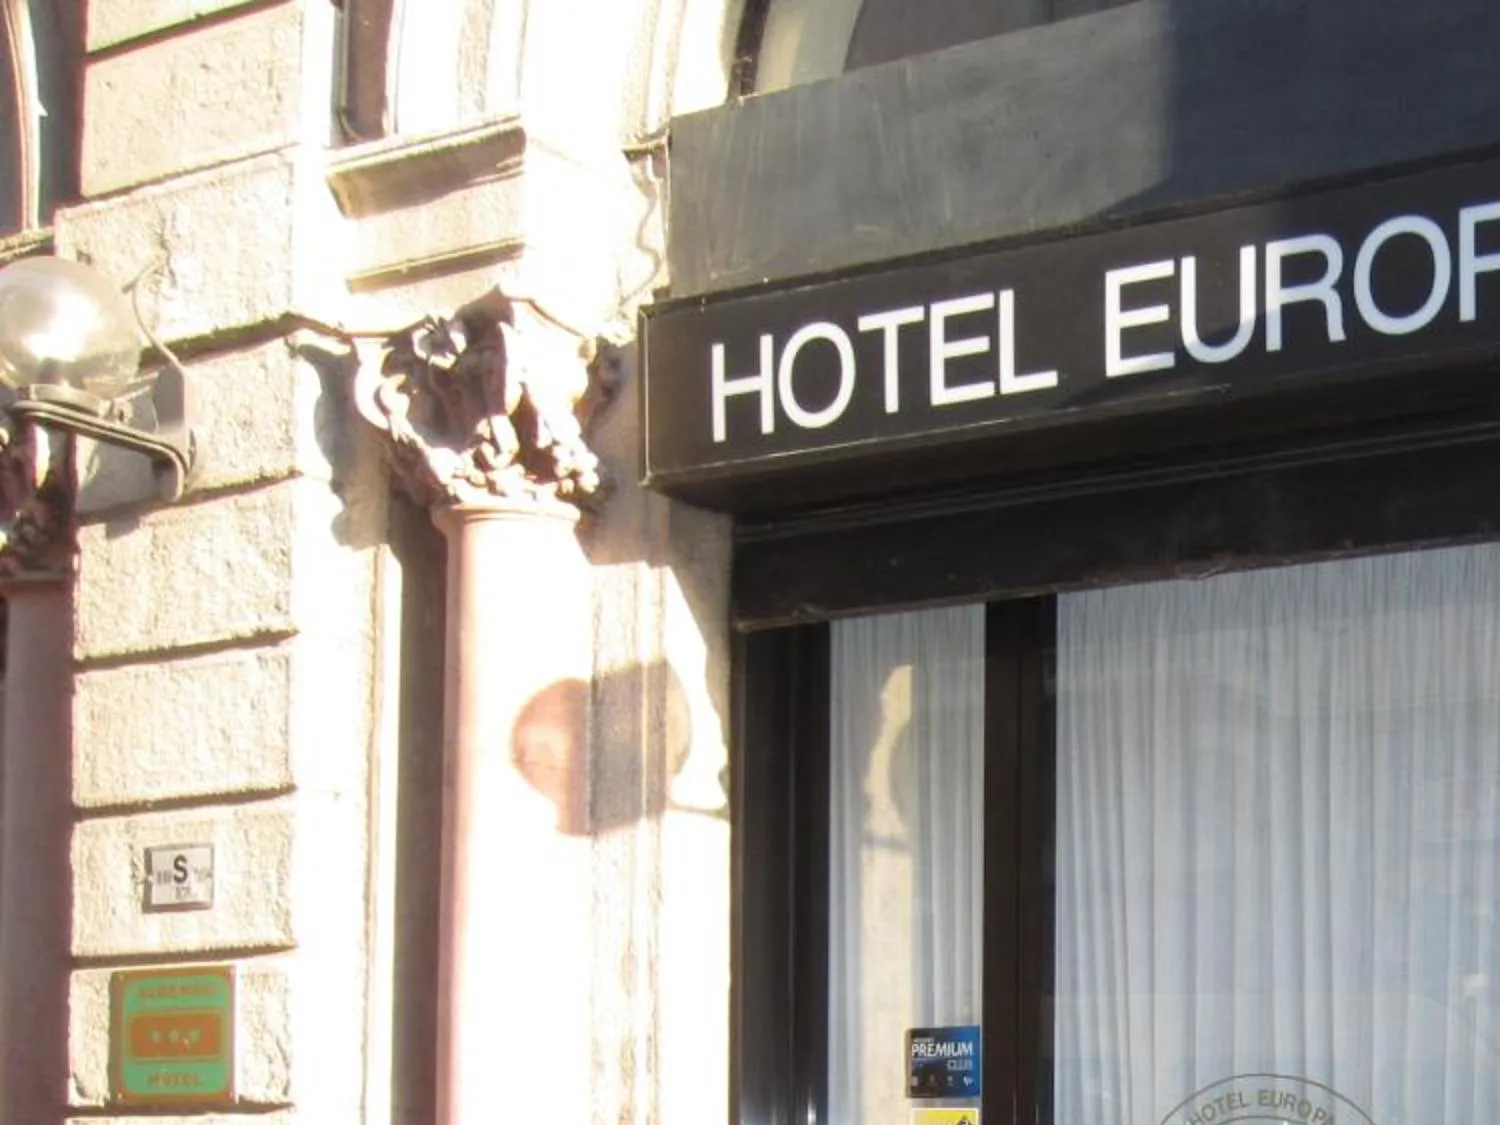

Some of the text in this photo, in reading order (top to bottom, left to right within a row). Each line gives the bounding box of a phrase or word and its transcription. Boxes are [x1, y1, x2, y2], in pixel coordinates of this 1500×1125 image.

[711, 289, 1058, 443] HOTEL
[173, 853, 188, 884] S
[911, 1041, 974, 1057] PREMIUM
